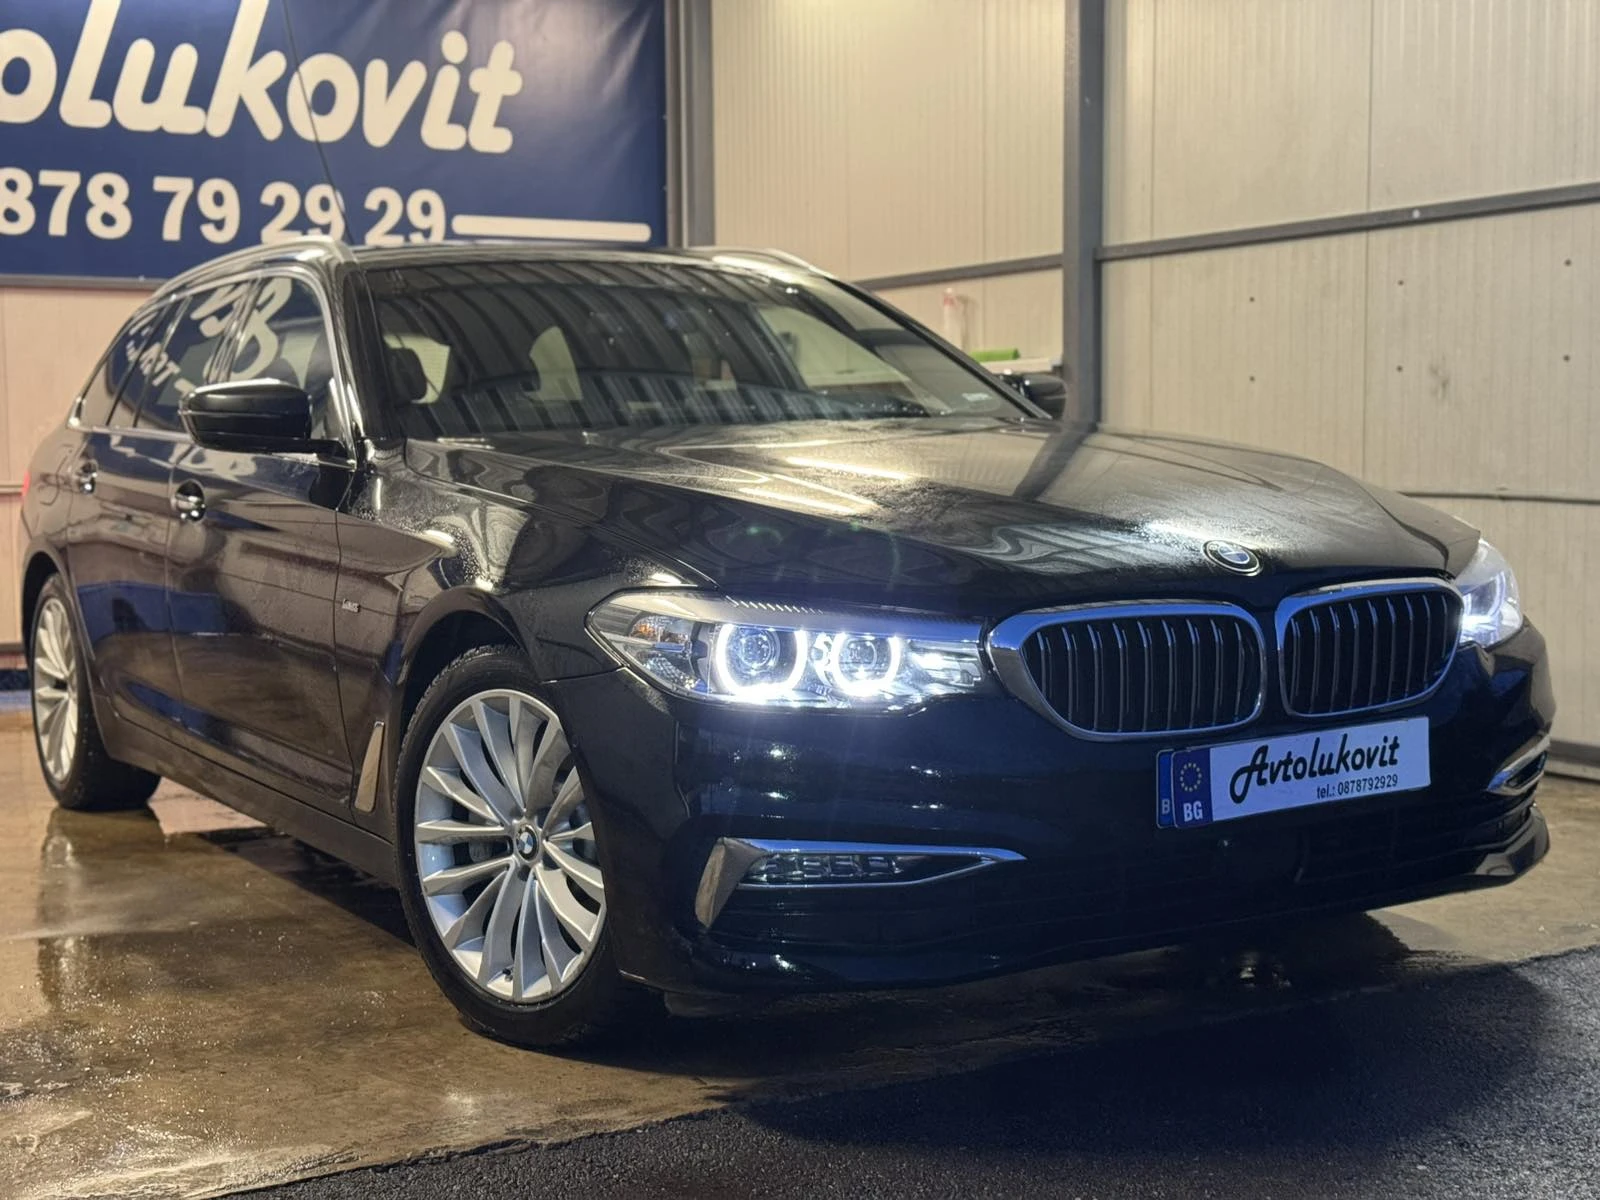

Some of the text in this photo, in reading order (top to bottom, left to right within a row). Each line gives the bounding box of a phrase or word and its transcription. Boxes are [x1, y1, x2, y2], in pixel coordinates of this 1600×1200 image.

[0, 167, 446, 248] 878 79 29 29
[1229, 733, 1400, 804] Avtolukovit
[1337, 774, 1398, 796] 0878792929
[1183, 800, 1203, 822] BG
